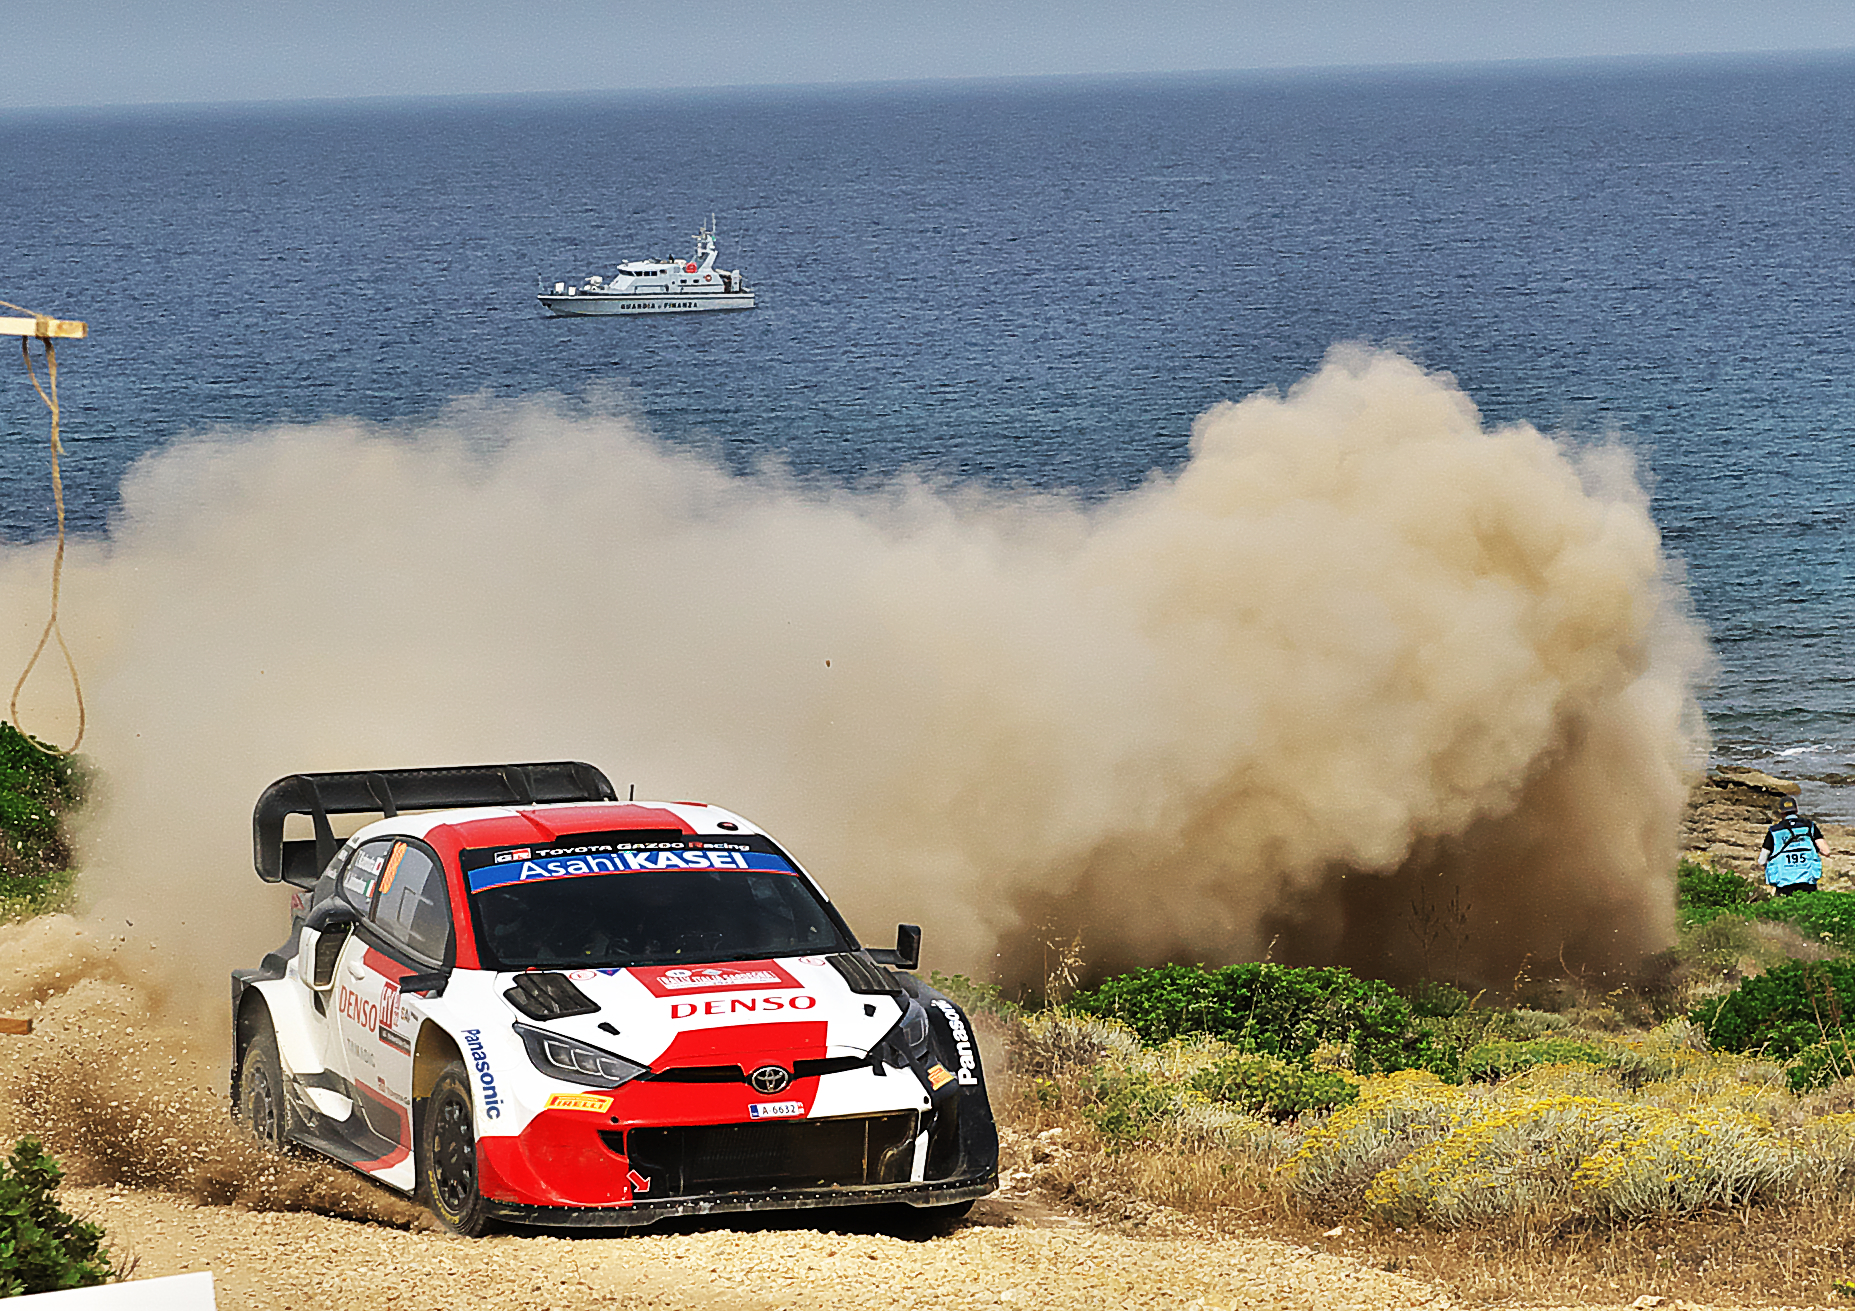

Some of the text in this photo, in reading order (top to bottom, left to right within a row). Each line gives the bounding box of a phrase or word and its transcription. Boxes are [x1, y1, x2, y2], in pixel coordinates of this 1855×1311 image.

[620, 302, 656, 310] GUARDIA
[663, 301, 698, 309] FINANZA
[495, 848, 530, 862] GR
[535, 841, 750, 857] TOYOTA GAZOO Racing
[1785, 852, 1806, 864] 195
[339, 984, 378, 1034] DENSO
[670, 995, 816, 1019] DENSO
[460, 1030, 504, 1120] Panasonic
